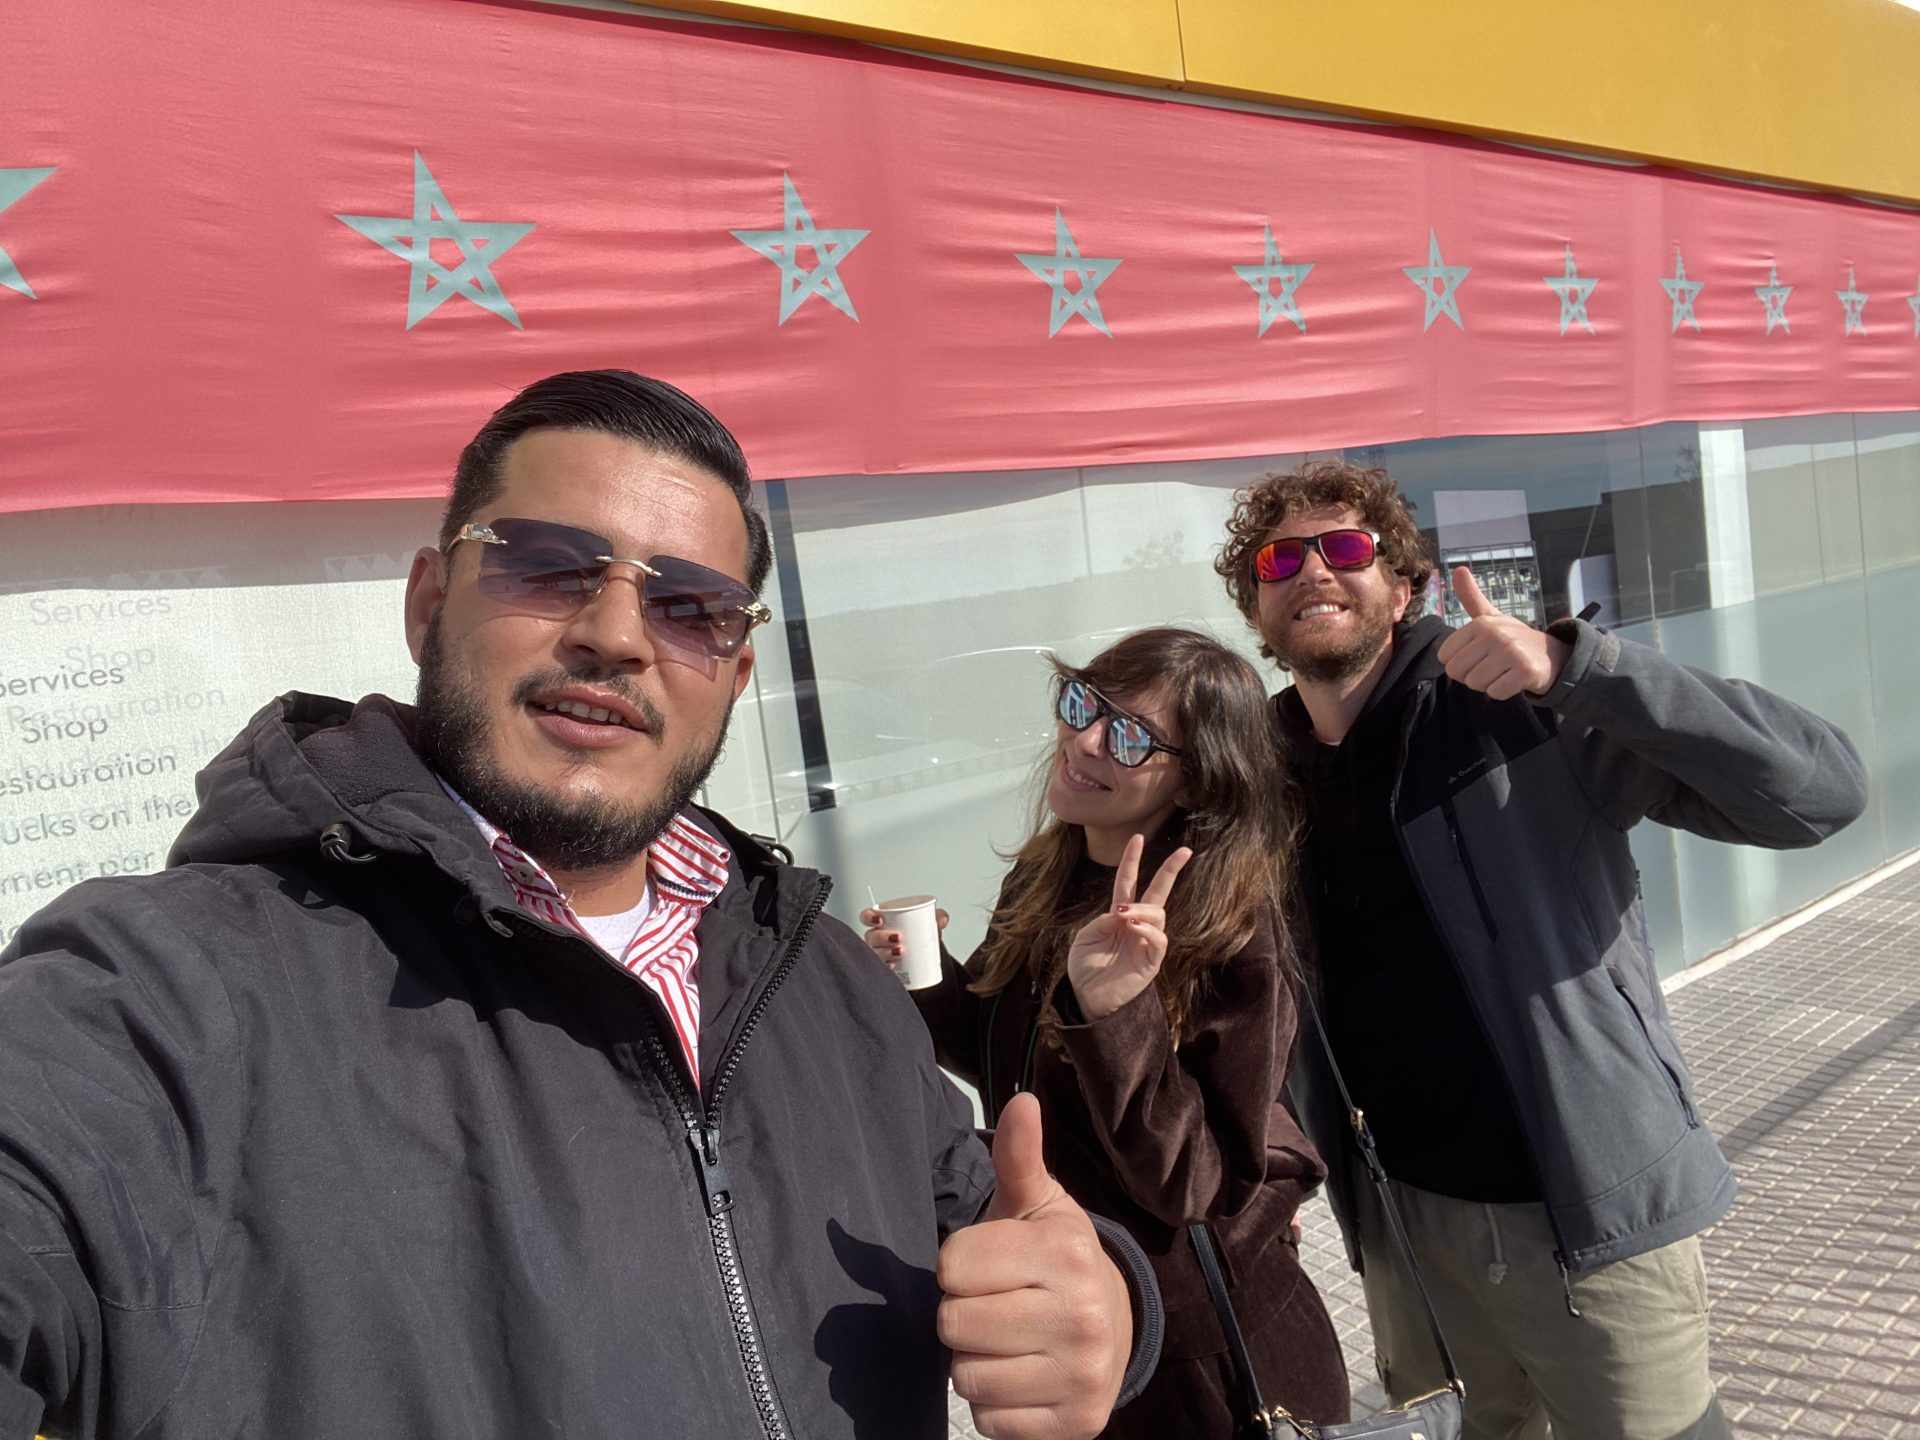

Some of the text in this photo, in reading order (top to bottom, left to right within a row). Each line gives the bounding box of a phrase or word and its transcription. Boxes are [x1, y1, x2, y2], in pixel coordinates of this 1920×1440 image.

[30, 591, 173, 626] Services
[65, 643, 157, 674] Shop
[20, 713, 109, 744] Shop
